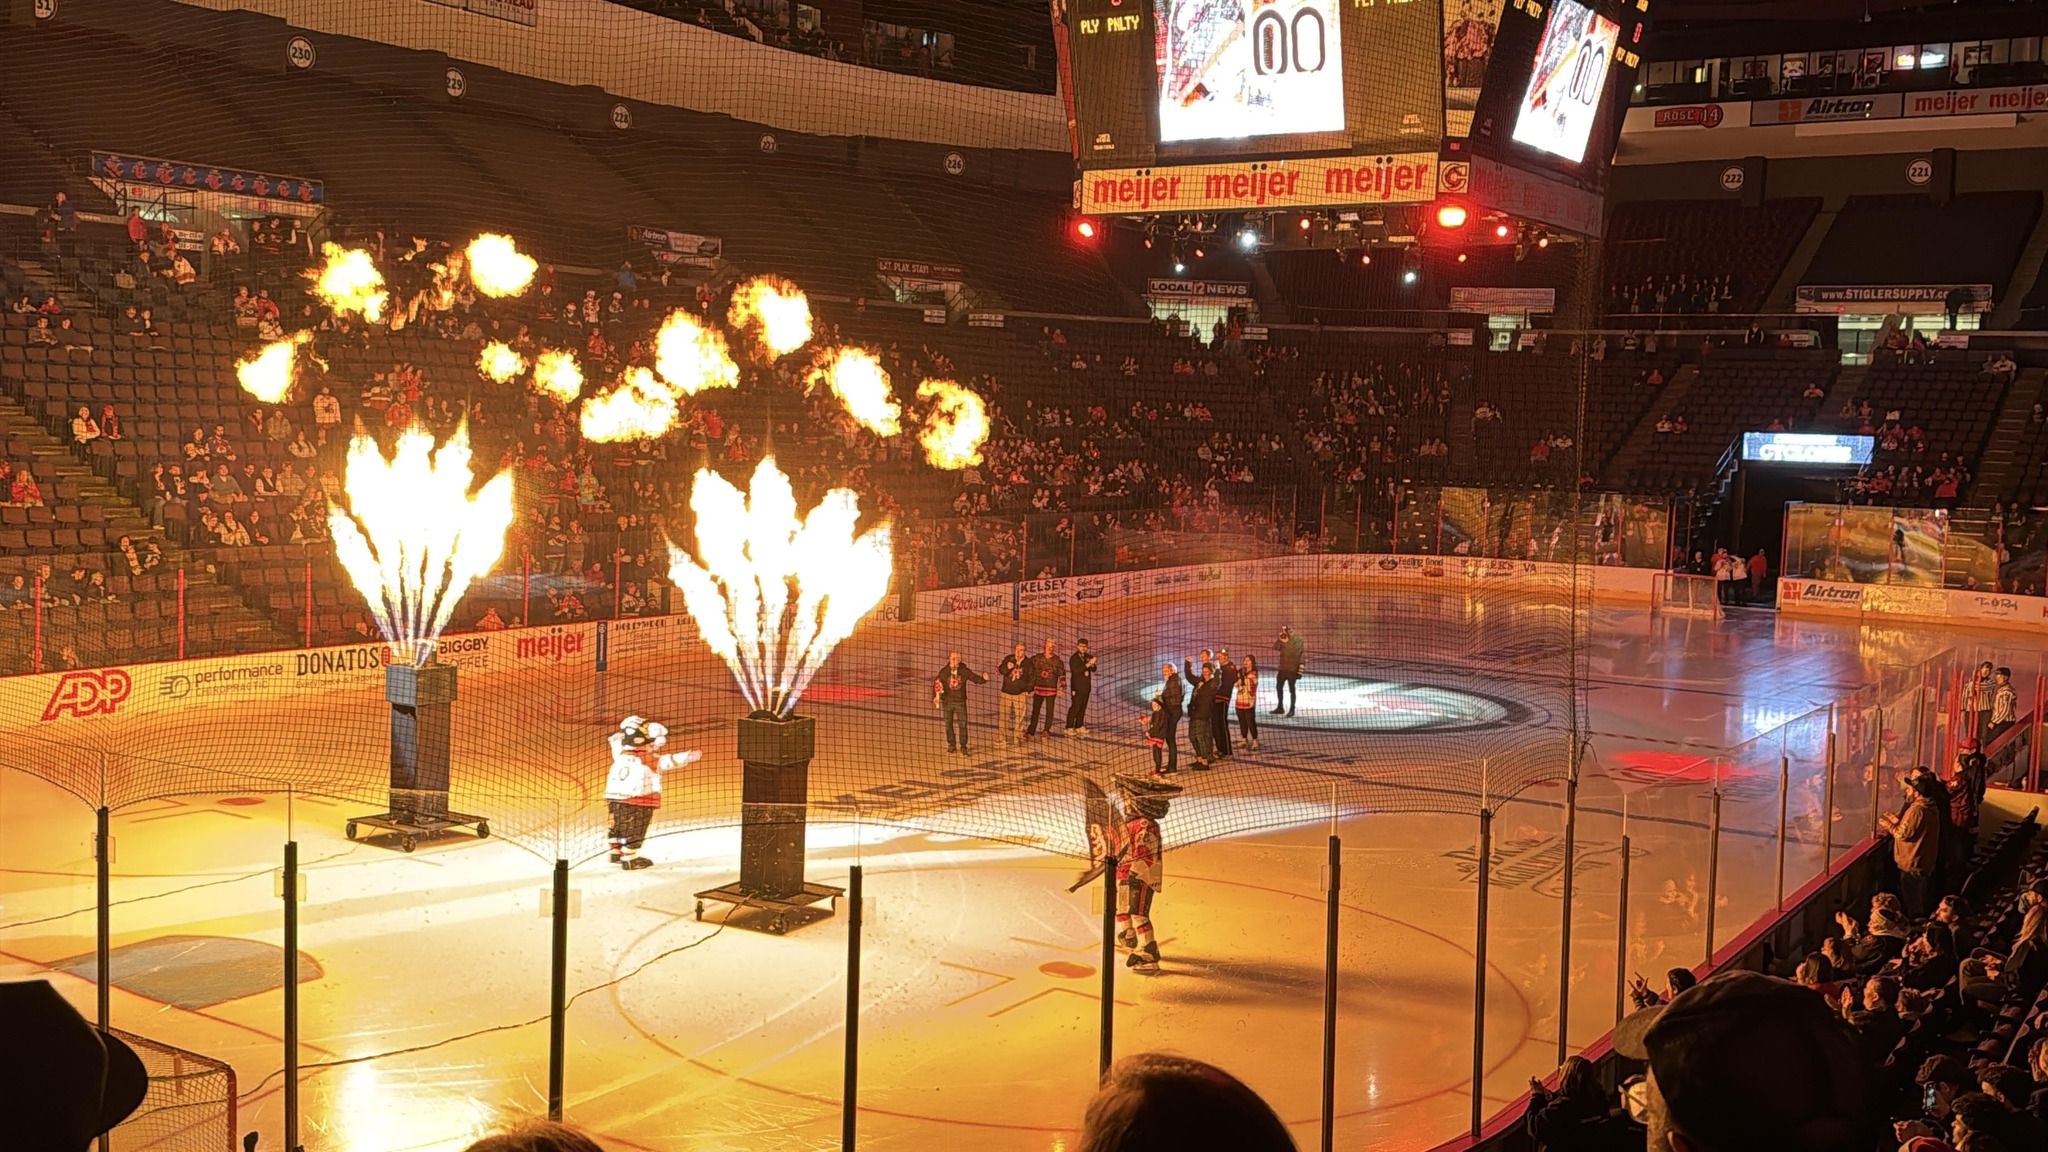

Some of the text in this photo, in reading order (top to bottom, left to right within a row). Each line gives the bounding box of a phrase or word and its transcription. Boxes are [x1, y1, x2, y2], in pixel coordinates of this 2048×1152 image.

[1081, 15, 1140, 34] PLY PNLTY
[291, 46, 311, 61] 230
[447, 77, 463, 91] 229
[1806, 99, 1874, 114] Airtron
[1914, 91, 1979, 113] meijer
[614, 112, 629, 124] 228
[1663, 108, 1719, 122] ROSE 14
[946, 158, 962, 170] 226
[1911, 166, 1929, 178] 221
[1093, 169, 1181, 209] meijer
[1205, 163, 1300, 205] meijer
[1325, 156, 1428, 199] meijer
[1724, 173, 1742, 184] 222
[1151, 282, 1248, 295] LOCAL 12 NEWS
[1020, 578, 1067, 594] KELSEY
[1803, 584, 1861, 600] Airtron
[950, 593, 979, 612] Coors
[978, 595, 1003, 608] LIGHT
[439, 637, 489, 655] BIGGBY
[516, 627, 585, 661] meijer
[296, 646, 380, 677] DONATOS
[195, 664, 283, 687] performance
[41, 669, 132, 721] ADP
